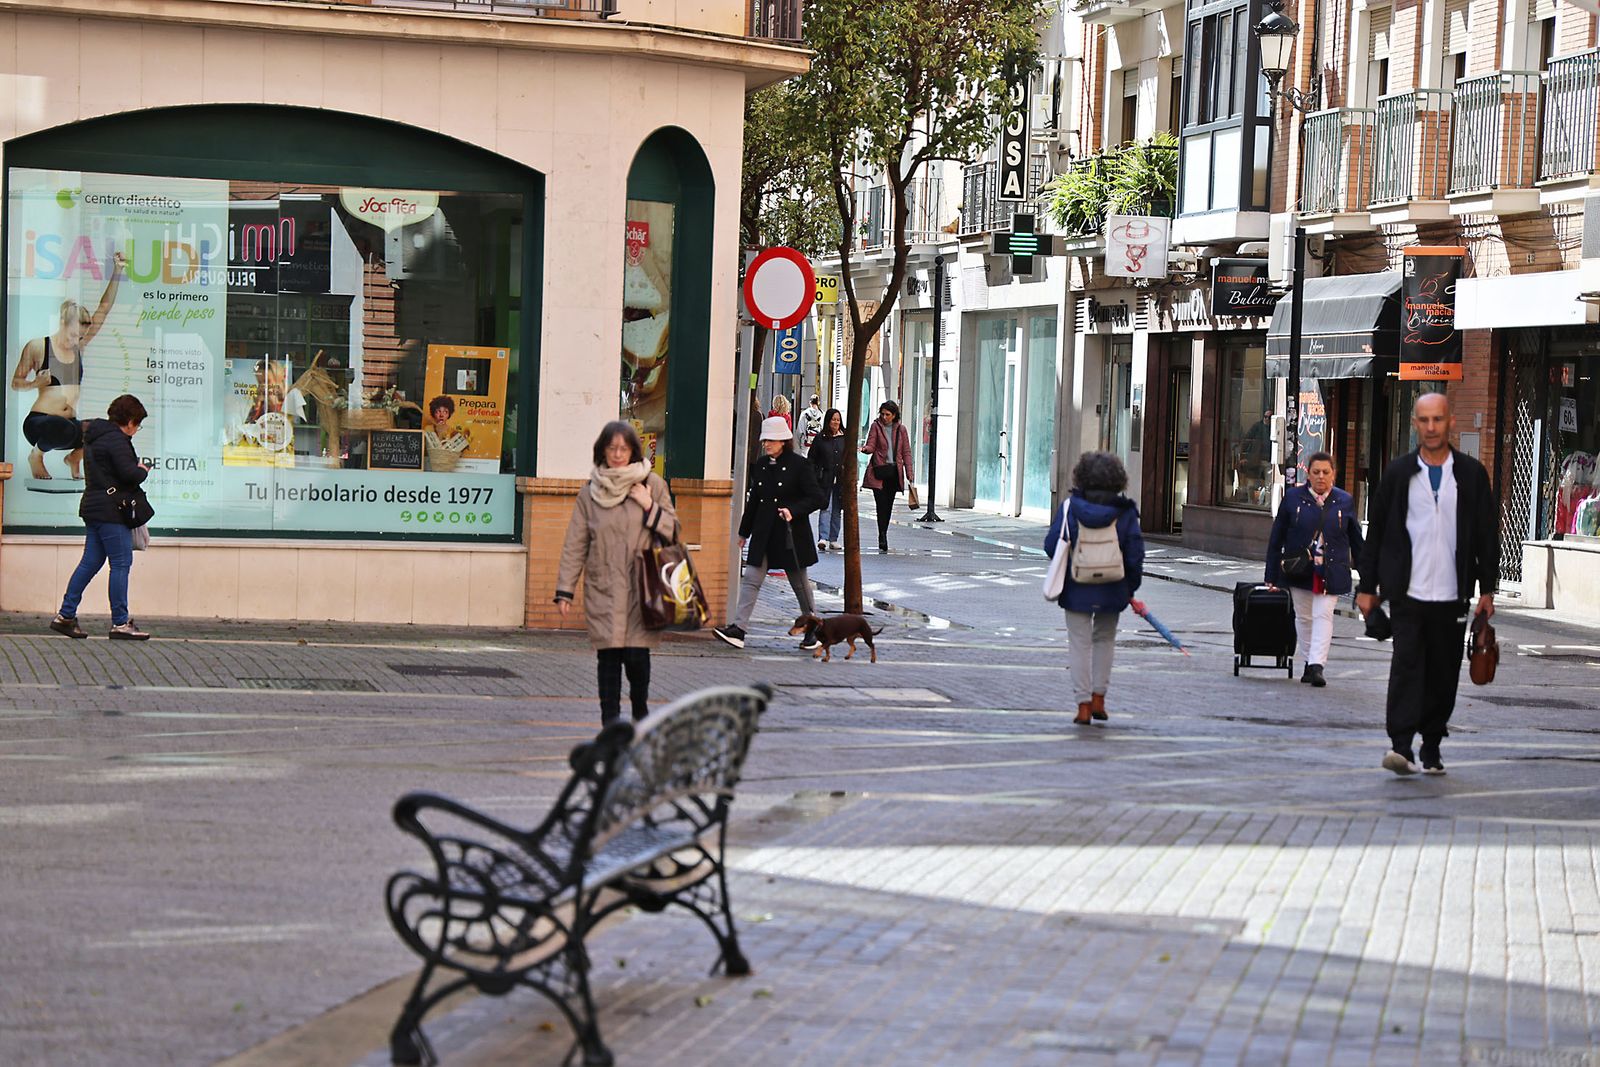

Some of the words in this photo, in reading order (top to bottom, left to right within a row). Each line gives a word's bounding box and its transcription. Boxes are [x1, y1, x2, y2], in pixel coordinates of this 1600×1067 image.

[143, 291, 154, 299] es
[157, 290, 166, 300] lo
[169, 291, 209, 302] primero
[136, 302, 182, 328] pierde
[182, 308, 215, 328] peso
[146, 357, 164, 369] las
[167, 360, 205, 371] metas
[147, 374, 160, 384] se
[164, 373, 203, 387] logran
[459, 398, 496, 410] Prepara
[245, 482, 267, 501] Tu
[275, 482, 378, 503] herbolario
[384, 485, 441, 505] desde
[447, 487, 494, 505] 1977
